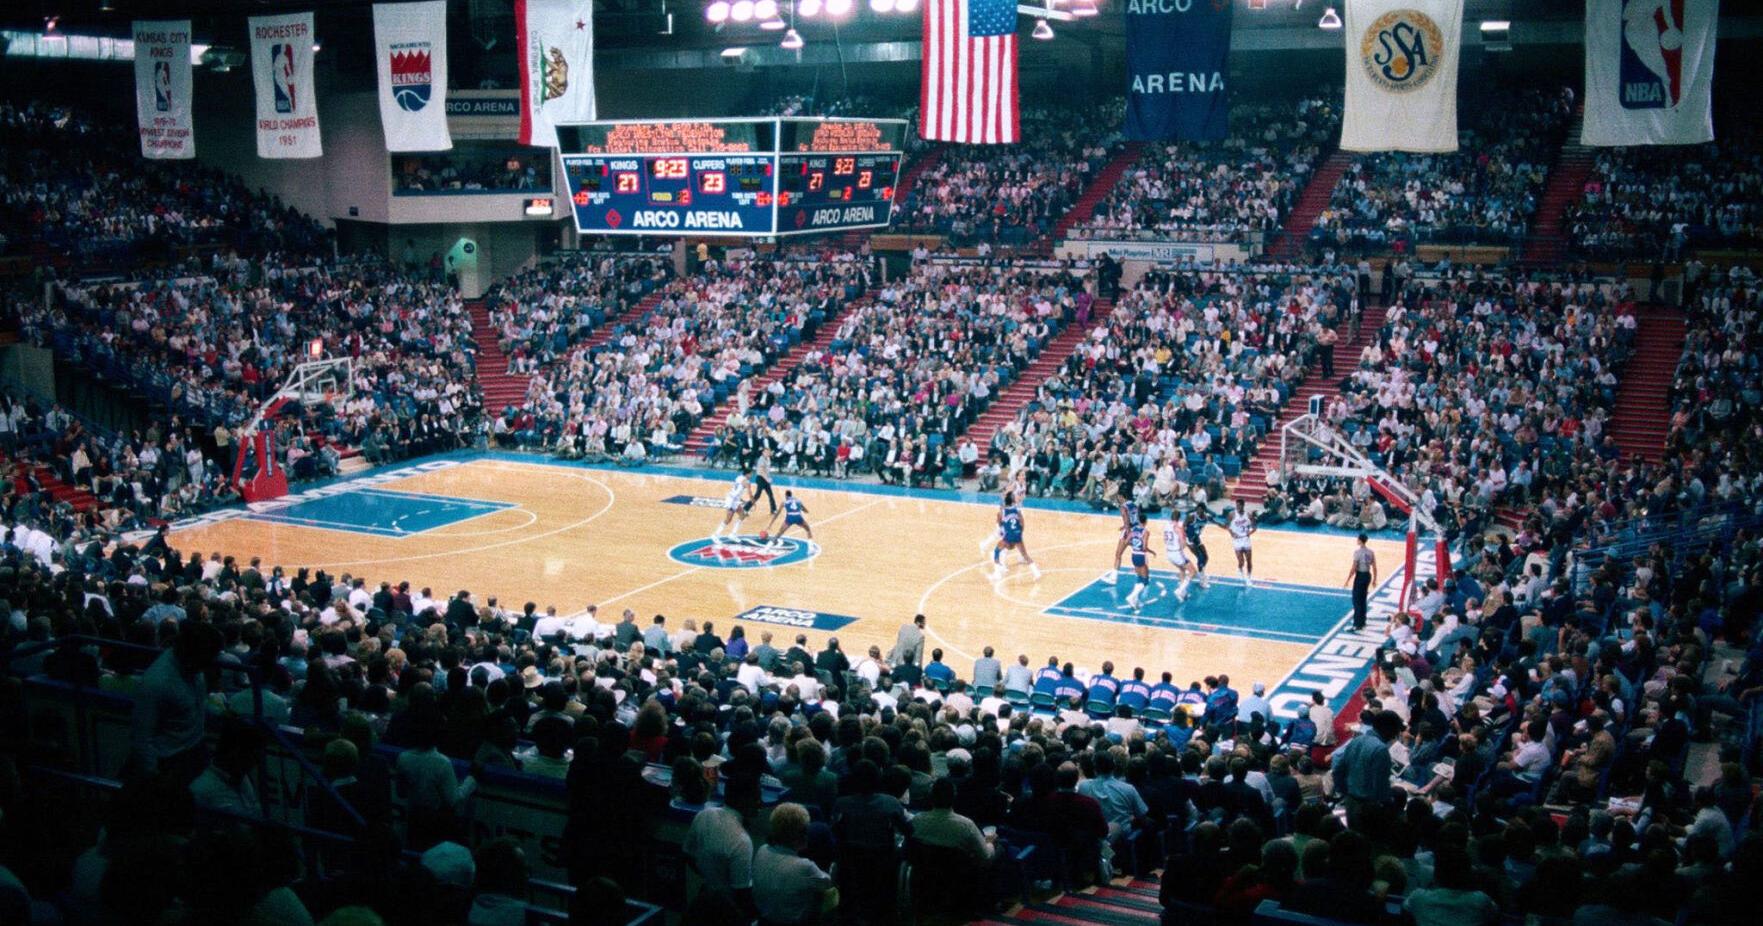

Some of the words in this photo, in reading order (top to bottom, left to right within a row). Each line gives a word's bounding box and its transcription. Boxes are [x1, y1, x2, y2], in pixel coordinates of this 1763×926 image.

[1127, 0, 1192, 14] ARCO
[136, 32, 167, 44] KANSAS
[169, 32, 188, 44] CITY
[255, 23, 308, 39] ROCHESTER
[150, 47, 174, 58] KINGS
[393, 72, 430, 83] KINGS
[1132, 72, 1224, 93] ARENA
[1625, 81, 1662, 102] NBA
[446, 102, 471, 112] RCO
[473, 102, 514, 112] ARENA
[279, 136, 297, 145] 1951
[611, 161, 638, 170] KINGS
[655, 159, 687, 178] 9:23
[693, 160, 725, 170] CLIPPERS
[809, 159, 827, 168] KINGS
[834, 158, 855, 175] 9:23
[618, 173, 638, 191] 27
[704, 173, 724, 191] 23
[809, 172, 823, 190] 27
[858, 171, 872, 188] 23
[681, 189, 691, 204] 2
[633, 211, 679, 228] ARCO
[684, 211, 743, 229] ARENA
[812, 208, 841, 225] ARCO
[842, 206, 875, 223] ARENA
[1010, 519, 1017, 529] 2
[742, 612, 814, 627] ARENA
[755, 608, 816, 619] ARCO
